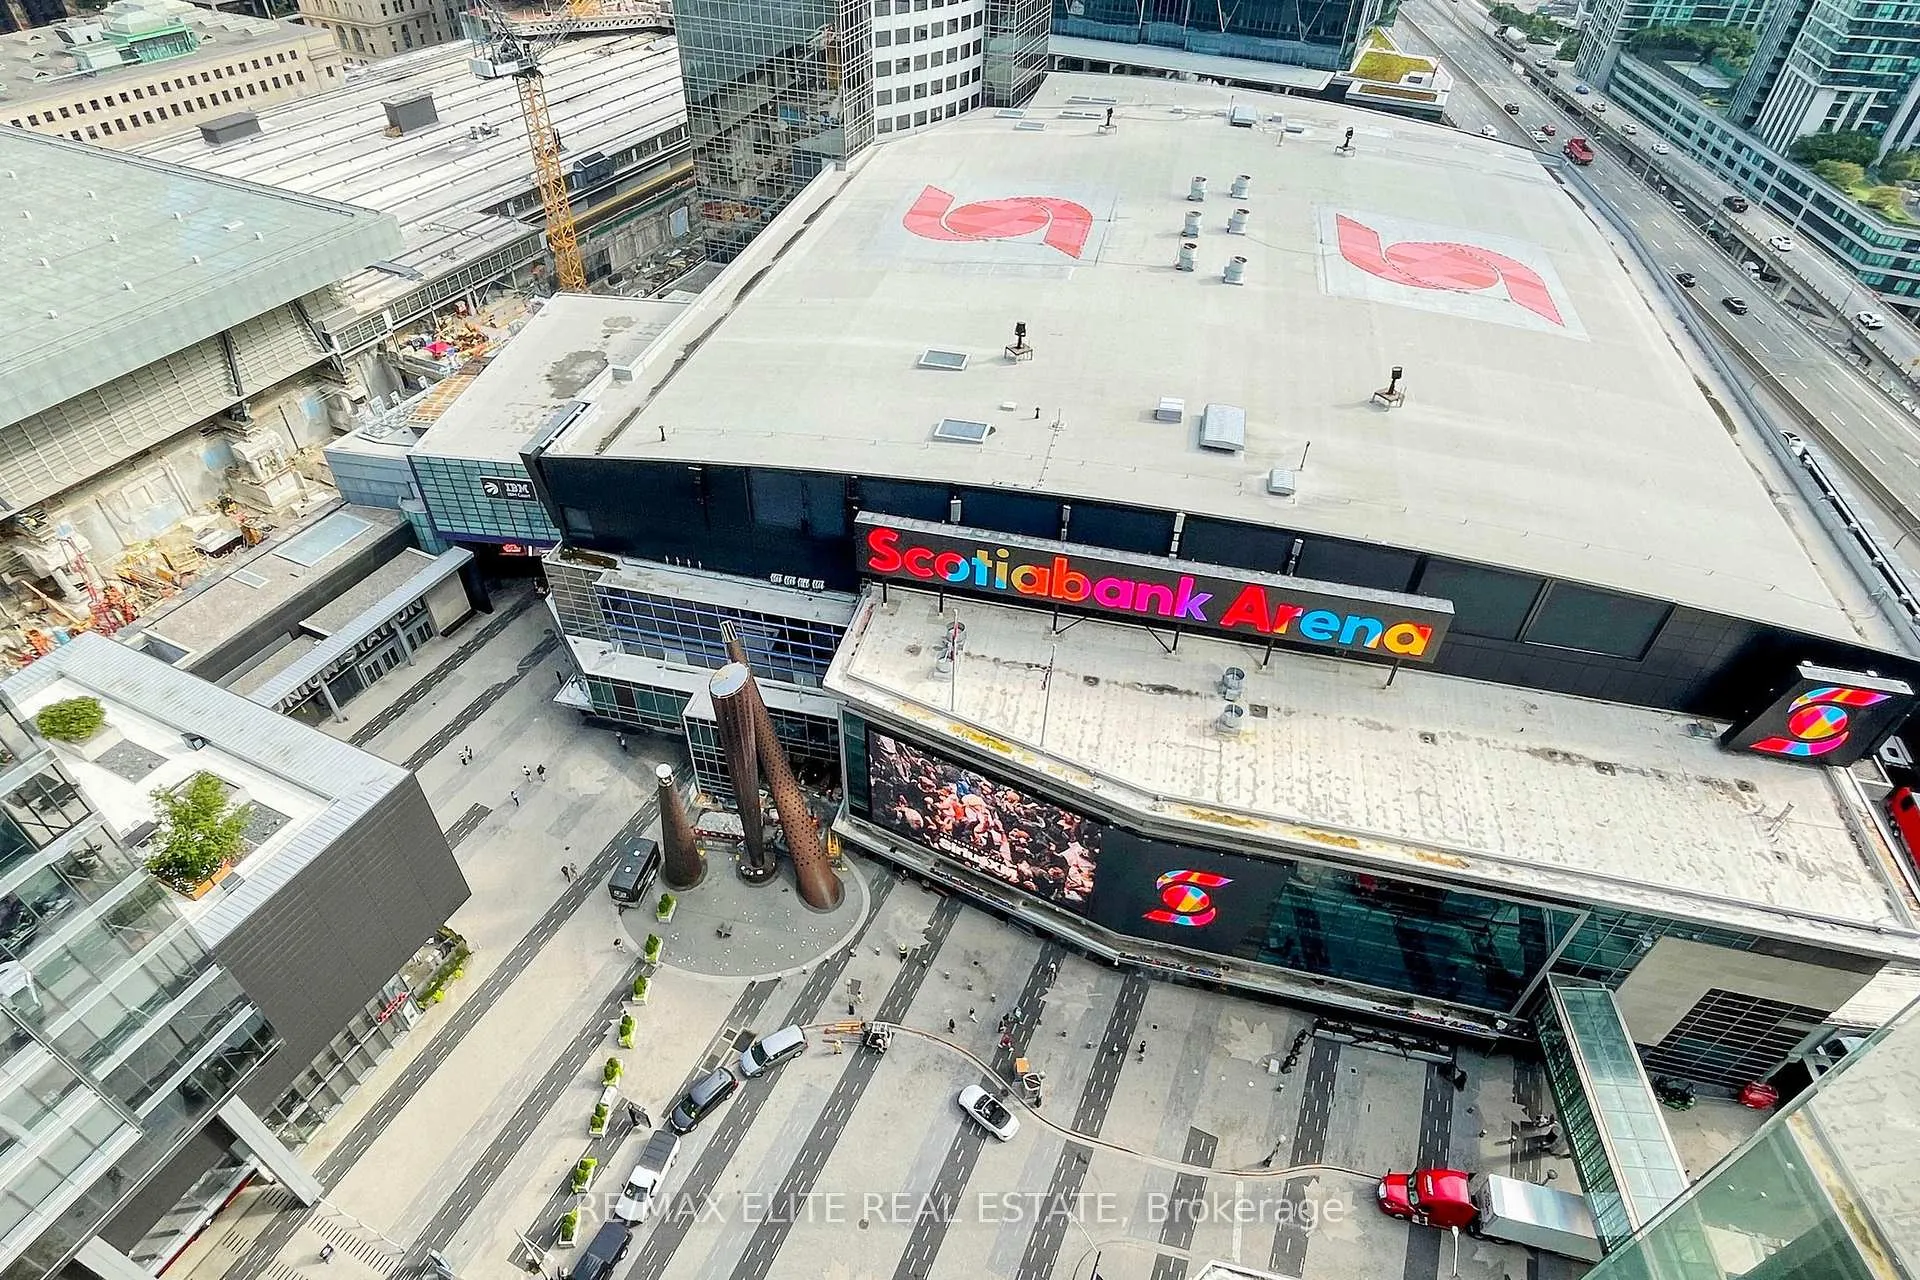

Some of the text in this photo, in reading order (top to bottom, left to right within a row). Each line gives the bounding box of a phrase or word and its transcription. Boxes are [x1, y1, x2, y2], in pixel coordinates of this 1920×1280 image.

[504, 482, 530, 493] IBM
[866, 527, 1433, 656] Scotiabank Arena
